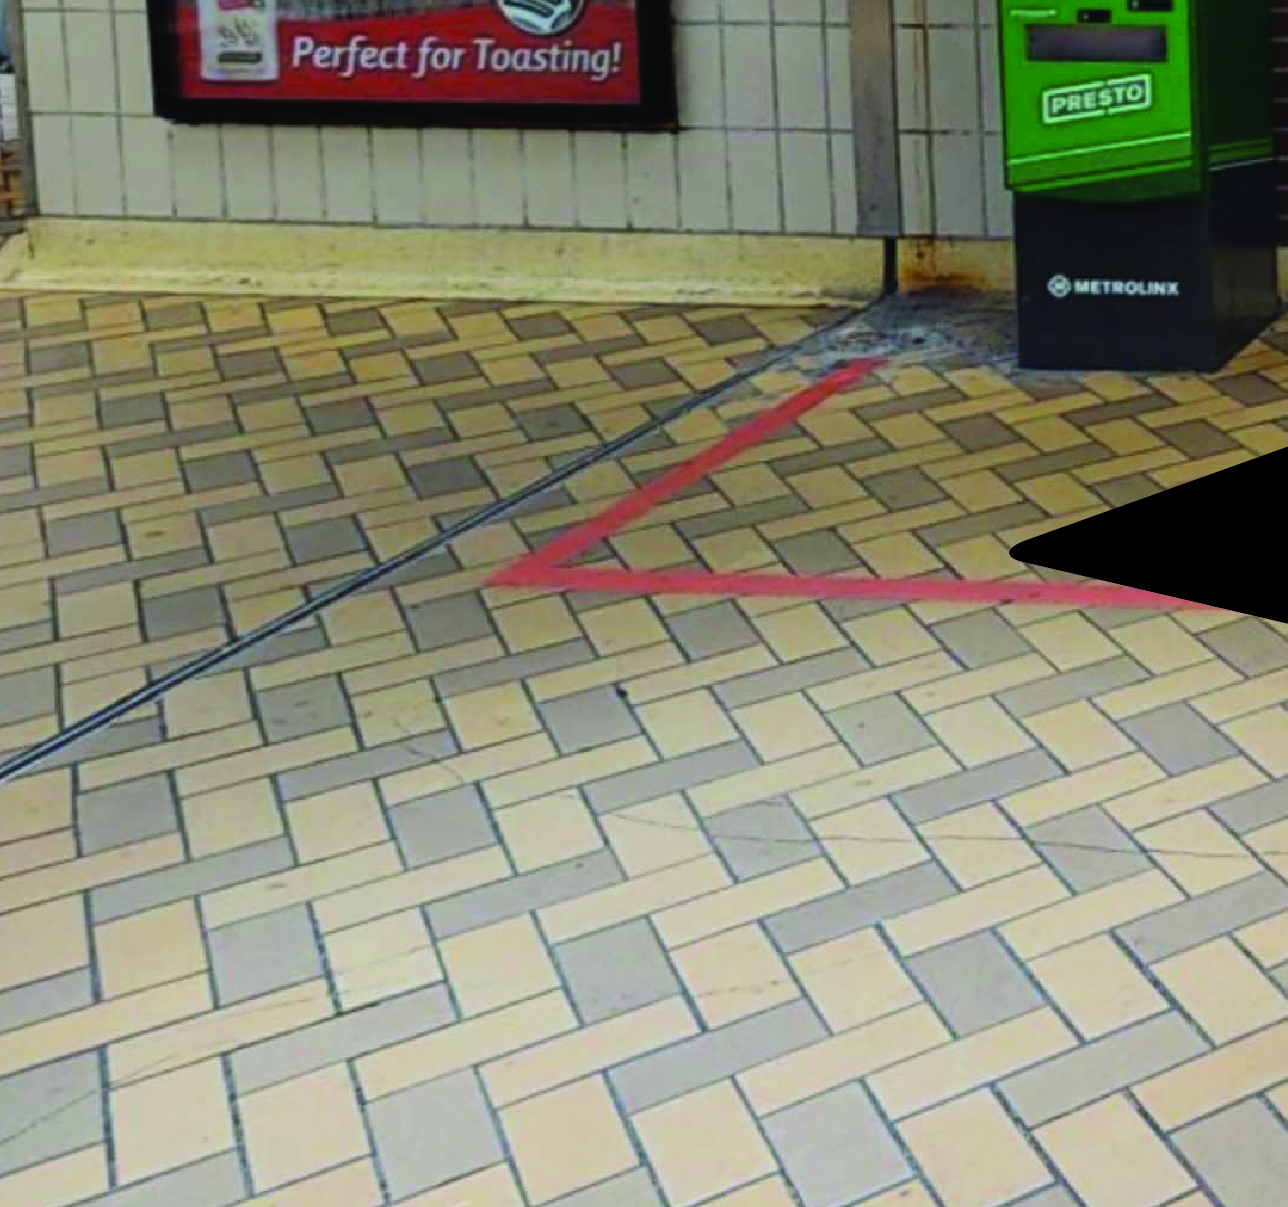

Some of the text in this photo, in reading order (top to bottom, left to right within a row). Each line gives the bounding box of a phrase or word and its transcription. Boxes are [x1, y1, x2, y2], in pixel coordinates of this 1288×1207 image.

[291, 35, 623, 82] Perfect for Toasting!
[1052, 83, 1143, 114] PRESTO
[1073, 278, 1179, 295] METROLINX
